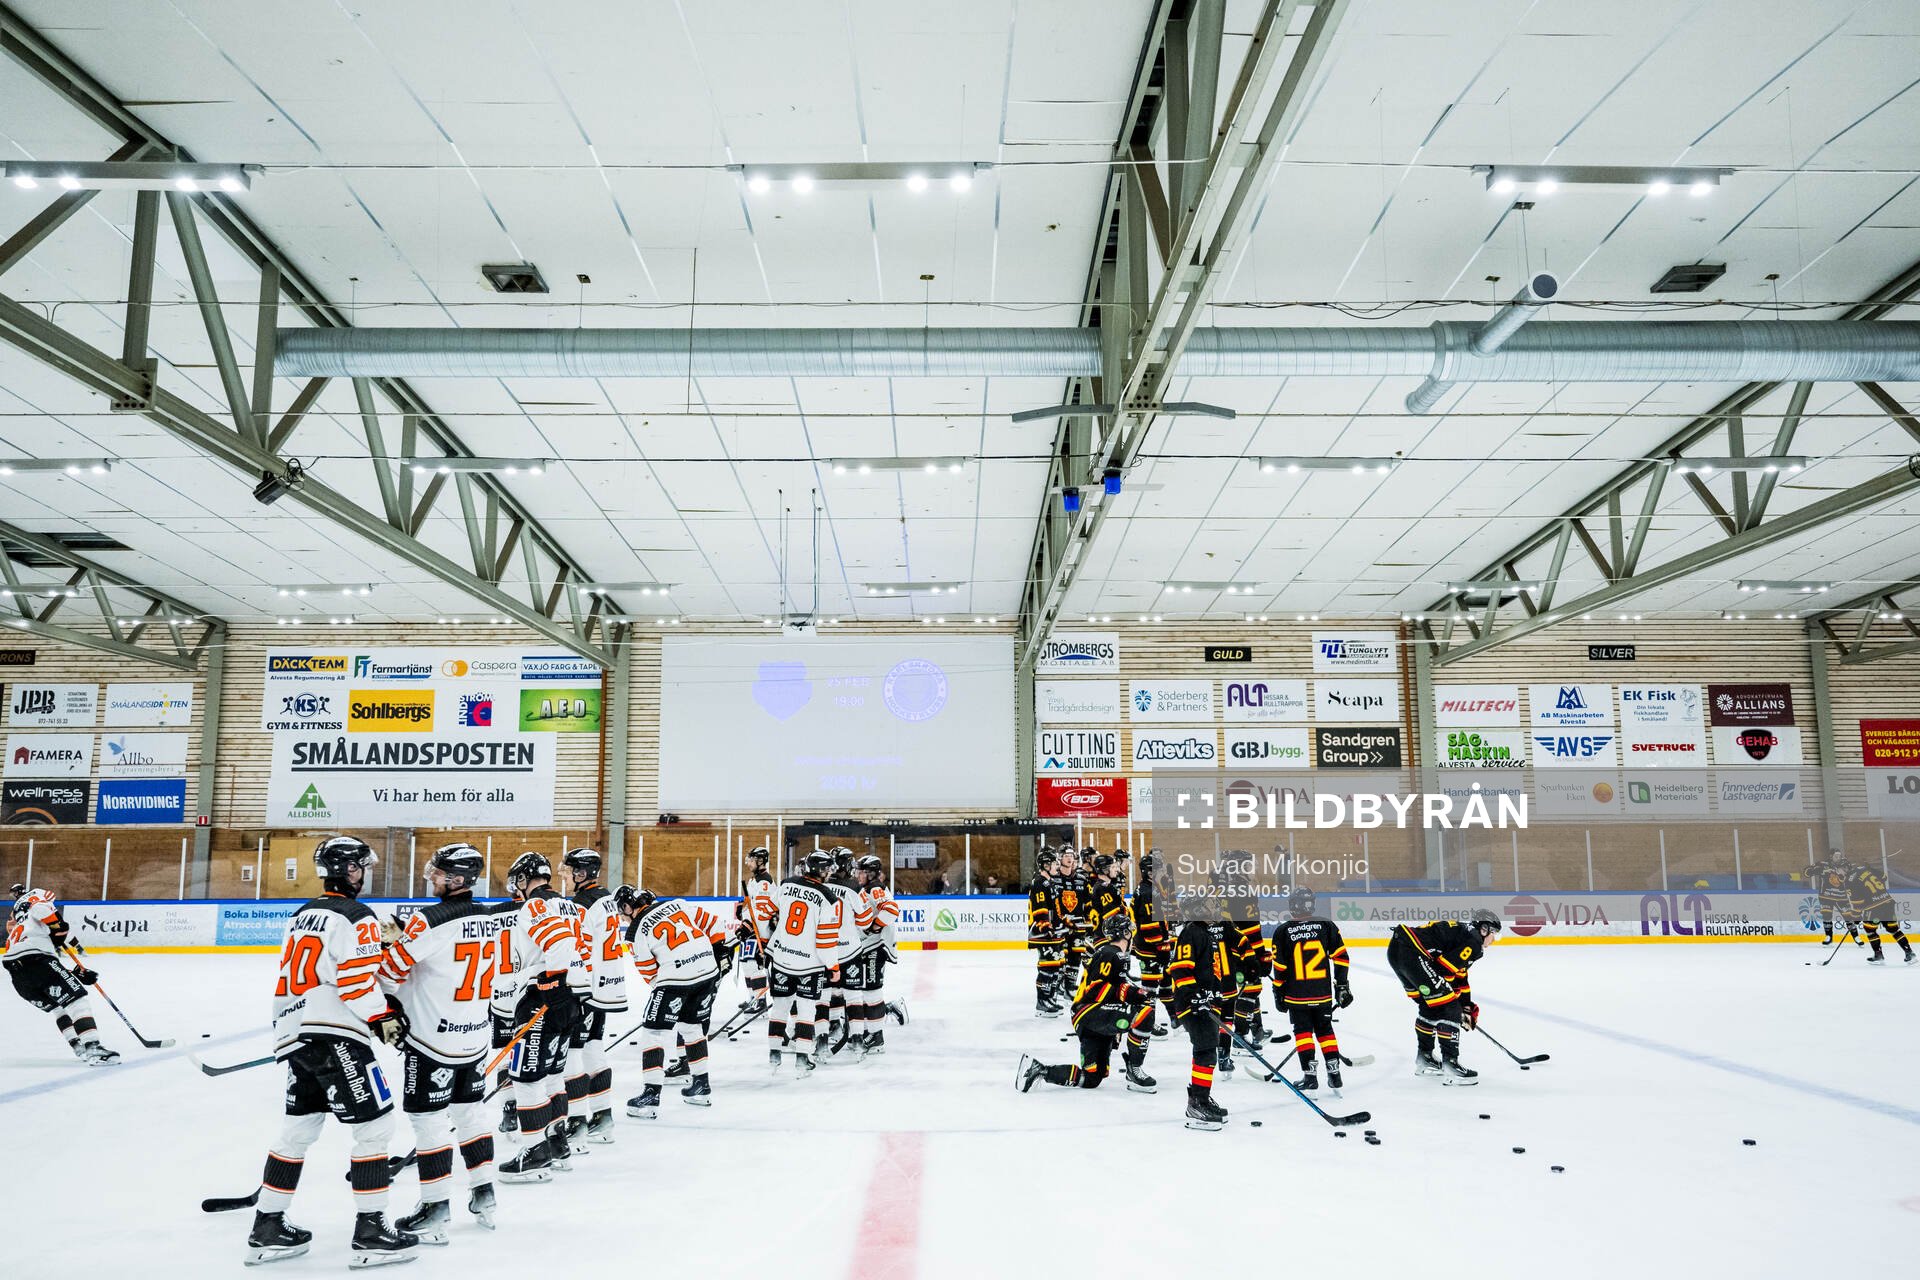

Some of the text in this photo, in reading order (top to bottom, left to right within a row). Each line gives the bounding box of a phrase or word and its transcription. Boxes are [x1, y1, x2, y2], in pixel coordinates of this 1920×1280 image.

[1212, 650, 1245, 661] GULD
[1590, 647, 1635, 660] SILVER
[372, 663, 433, 676] Farmartjänst
[471, 661, 517, 671] Caspera
[572, 662, 578, 671] &
[1040, 659, 1115, 667] MONTAGE AB
[294, 675, 336, 683] Regummering
[1157, 690, 1209, 703] Söderberg
[1327, 690, 1384, 711] Scapa
[1623, 690, 1677, 701] EK Fisk
[1157, 702, 1208, 712] & Partners
[1440, 700, 1516, 713] MILLTECH
[1735, 700, 1786, 710] ALLIANS
[351, 703, 431, 723] Sohlbergs
[266, 722, 343, 730] GYM & FITNESS
[1321, 732, 1396, 748] Sandgren
[1447, 730, 1482, 747] SÅG
[1865, 730, 1896, 738] SVERIGES
[1042, 732, 1116, 756] CUTTING
[1556, 736, 1594, 758] AVS
[1631, 744, 1696, 752] SVETRUCK
[1735, 736, 1779, 747] GEHAB
[30, 750, 83, 761] FAMERA
[291, 736, 535, 766] SMÅLANDSPOSTEN
[1136, 738, 1215, 761] Atteviks
[1231, 741, 1270, 759] GBJ
[1271, 744, 1305, 759] bygg.
[1447, 746, 1511, 761] MASKIN
[1874, 749, 1912, 758] 020-912
[117, 752, 154, 766] Allbo
[1067, 757, 1116, 770] SOLUTIONS
[1322, 749, 1369, 766] Group
[1438, 758, 1526, 769] ALVESTA service
[1051, 778, 1113, 788] ALVESTA BILDELAR
[1540, 783, 1585, 793] Sparbanken
[1721, 781, 1780, 793] Finnvedens
[1887, 775, 1920, 795] LO
[9, 787, 83, 798] wellness
[373, 788, 514, 802] Vi har hem för alla
[1654, 784, 1705, 796] Heidelberg
[1722, 790, 1779, 803] Lastvagnar
[51, 797, 83, 805] studio
[1566, 793, 1586, 802] Eken
[1655, 793, 1698, 802] Materials
[287, 810, 332, 819] ALLBOHUS
[762, 882, 768, 892] 3
[1035, 891, 1046, 903] 19
[1100, 891, 1114, 906] 20
[224, 910, 249, 919] Boka
[784, 900, 809, 937] 8
[895, 909, 925, 924] KE
[960, 912, 978, 924] BR.
[1543, 902, 1610, 926] VIDA
[1705, 914, 1750, 926] HISSAR &
[82, 913, 150, 938] Scapa
[224, 921, 262, 930] Atracco
[404, 914, 427, 940] 12
[652, 910, 705, 952] 27
[1288, 923, 1322, 935] Sandgren
[1706, 926, 1775, 938] RULLTRAPPOR
[356, 922, 382, 946] 20
[1176, 943, 1192, 960] 19
[1459, 946, 1473, 961] 8
[1293, 940, 1328, 981] 12
[453, 941, 495, 1002] 72
[647, 989, 665, 1022] Sweden
[523, 1026, 543, 1073] Sweden
[334, 1041, 373, 1104] Sweden Rock
[404, 1055, 418, 1096] Sweden
